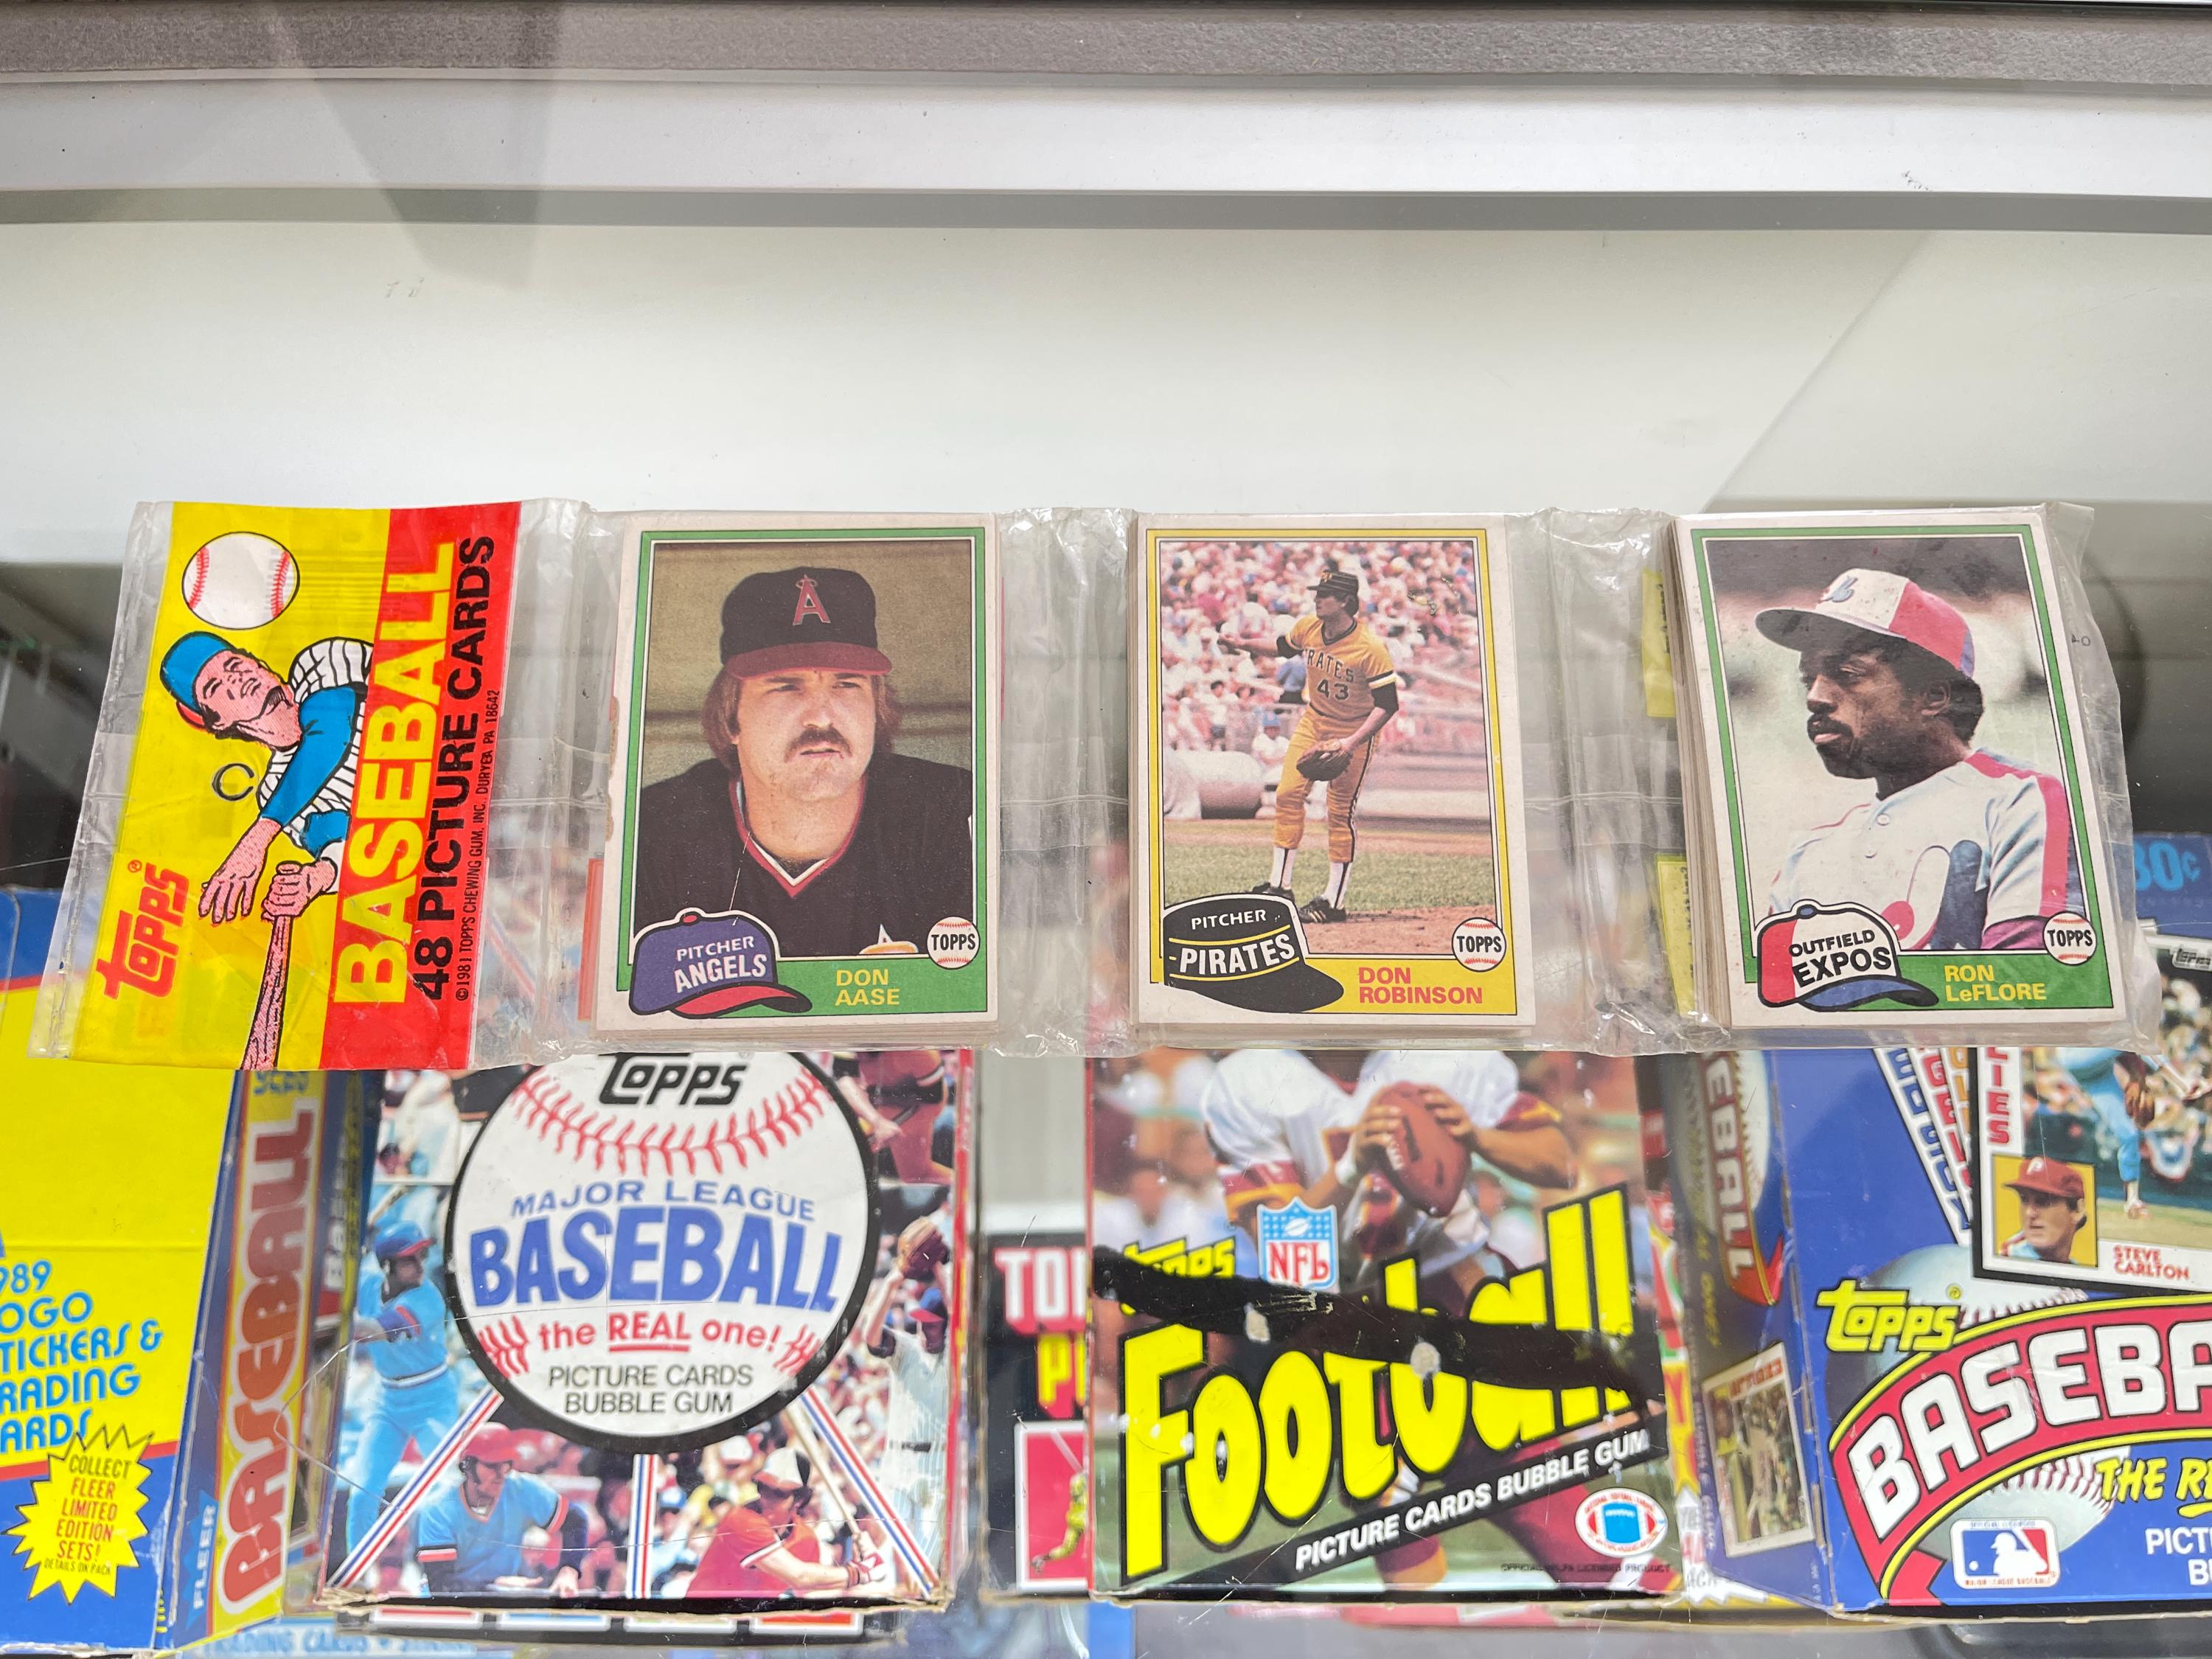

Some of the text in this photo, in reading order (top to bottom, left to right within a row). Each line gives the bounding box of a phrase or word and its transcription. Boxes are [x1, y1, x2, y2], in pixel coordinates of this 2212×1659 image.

[1305, 648, 1354, 682] RATES
[1317, 679, 1349, 700] 43
[486, 689, 500, 723] 18642
[483, 729, 495, 744] PA
[334, 542, 455, 1004] BASEBALL
[413, 535, 495, 1001] 48 PICTURE CARDS
[462, 860, 481, 914] CHEWING
[1191, 909, 1267, 931] PITCHER
[459, 917, 476, 953] TOPPS
[931, 933, 976, 950] TOPPS
[1457, 936, 1502, 953] TOPPS
[1788, 929, 1875, 957] OUTFIELD
[2047, 928, 2093, 947] TOPPS
[677, 936, 754, 961] PITCHER
[1179, 933, 1295, 975] PIRATES
[674, 951, 768, 993] ANGELS
[835, 969, 888, 987] DON
[1358, 967, 1411, 984] DON
[1792, 947, 1892, 988] EXPOS
[1944, 964, 1994, 982] RON
[835, 989, 900, 1006] AASE
[1359, 987, 1483, 1004] ROBINSON
[1945, 983, 2048, 1002] LeFLORE
[511, 1180, 815, 1222] MAJOR LEAGUE
[470, 1205, 842, 1313] BASEBALL
[1265, 1239, 1329, 1284] NFL
[2112, 1245, 2160, 1261] STEVE
[2113, 1261, 2190, 1280] CARLTON
[1817, 1279, 1961, 1353] Topps
[139, 1319, 164, 1352] &
[538, 1312, 782, 1352] the REAL one!
[222, 1108, 316, 1609] BASEBALL
[549, 1365, 754, 1389] PICTURE CARDS
[565, 1391, 732, 1416] BUBBLE GUM
[69, 1454, 131, 1480] COLLECT
[72, 1477, 116, 1499] FLEER
[2096, 1458, 2167, 1503] THE
[61, 1498, 117, 1522] LIMITED
[1294, 1430, 1649, 1572] PICTURE CARDS BUBBLE GUM
[56, 1518, 114, 1543] EDITION
[58, 1540, 101, 1562] SETS!
[192, 1504, 217, 1610] FLEER
